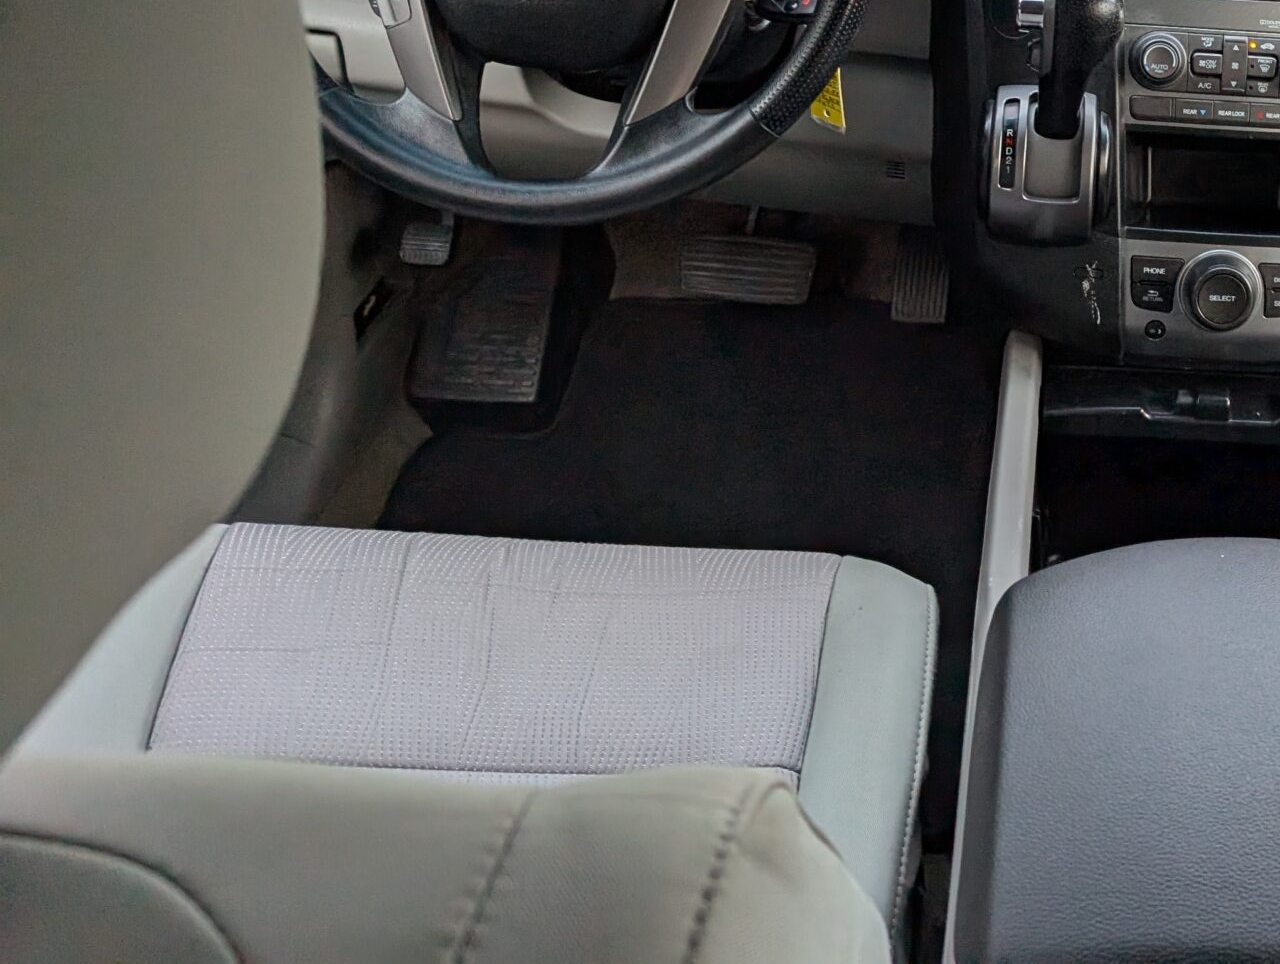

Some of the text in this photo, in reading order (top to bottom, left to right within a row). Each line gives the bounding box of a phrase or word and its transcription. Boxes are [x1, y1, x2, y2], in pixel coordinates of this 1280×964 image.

[1006, 128, 1014, 137] R
[1005, 138, 1013, 146] N
[1005, 146, 1013, 155] D
[1005, 156, 1012, 165] 2
[1143, 267, 1166, 275] PHONE
[1209, 294, 1236, 302] SELECT
